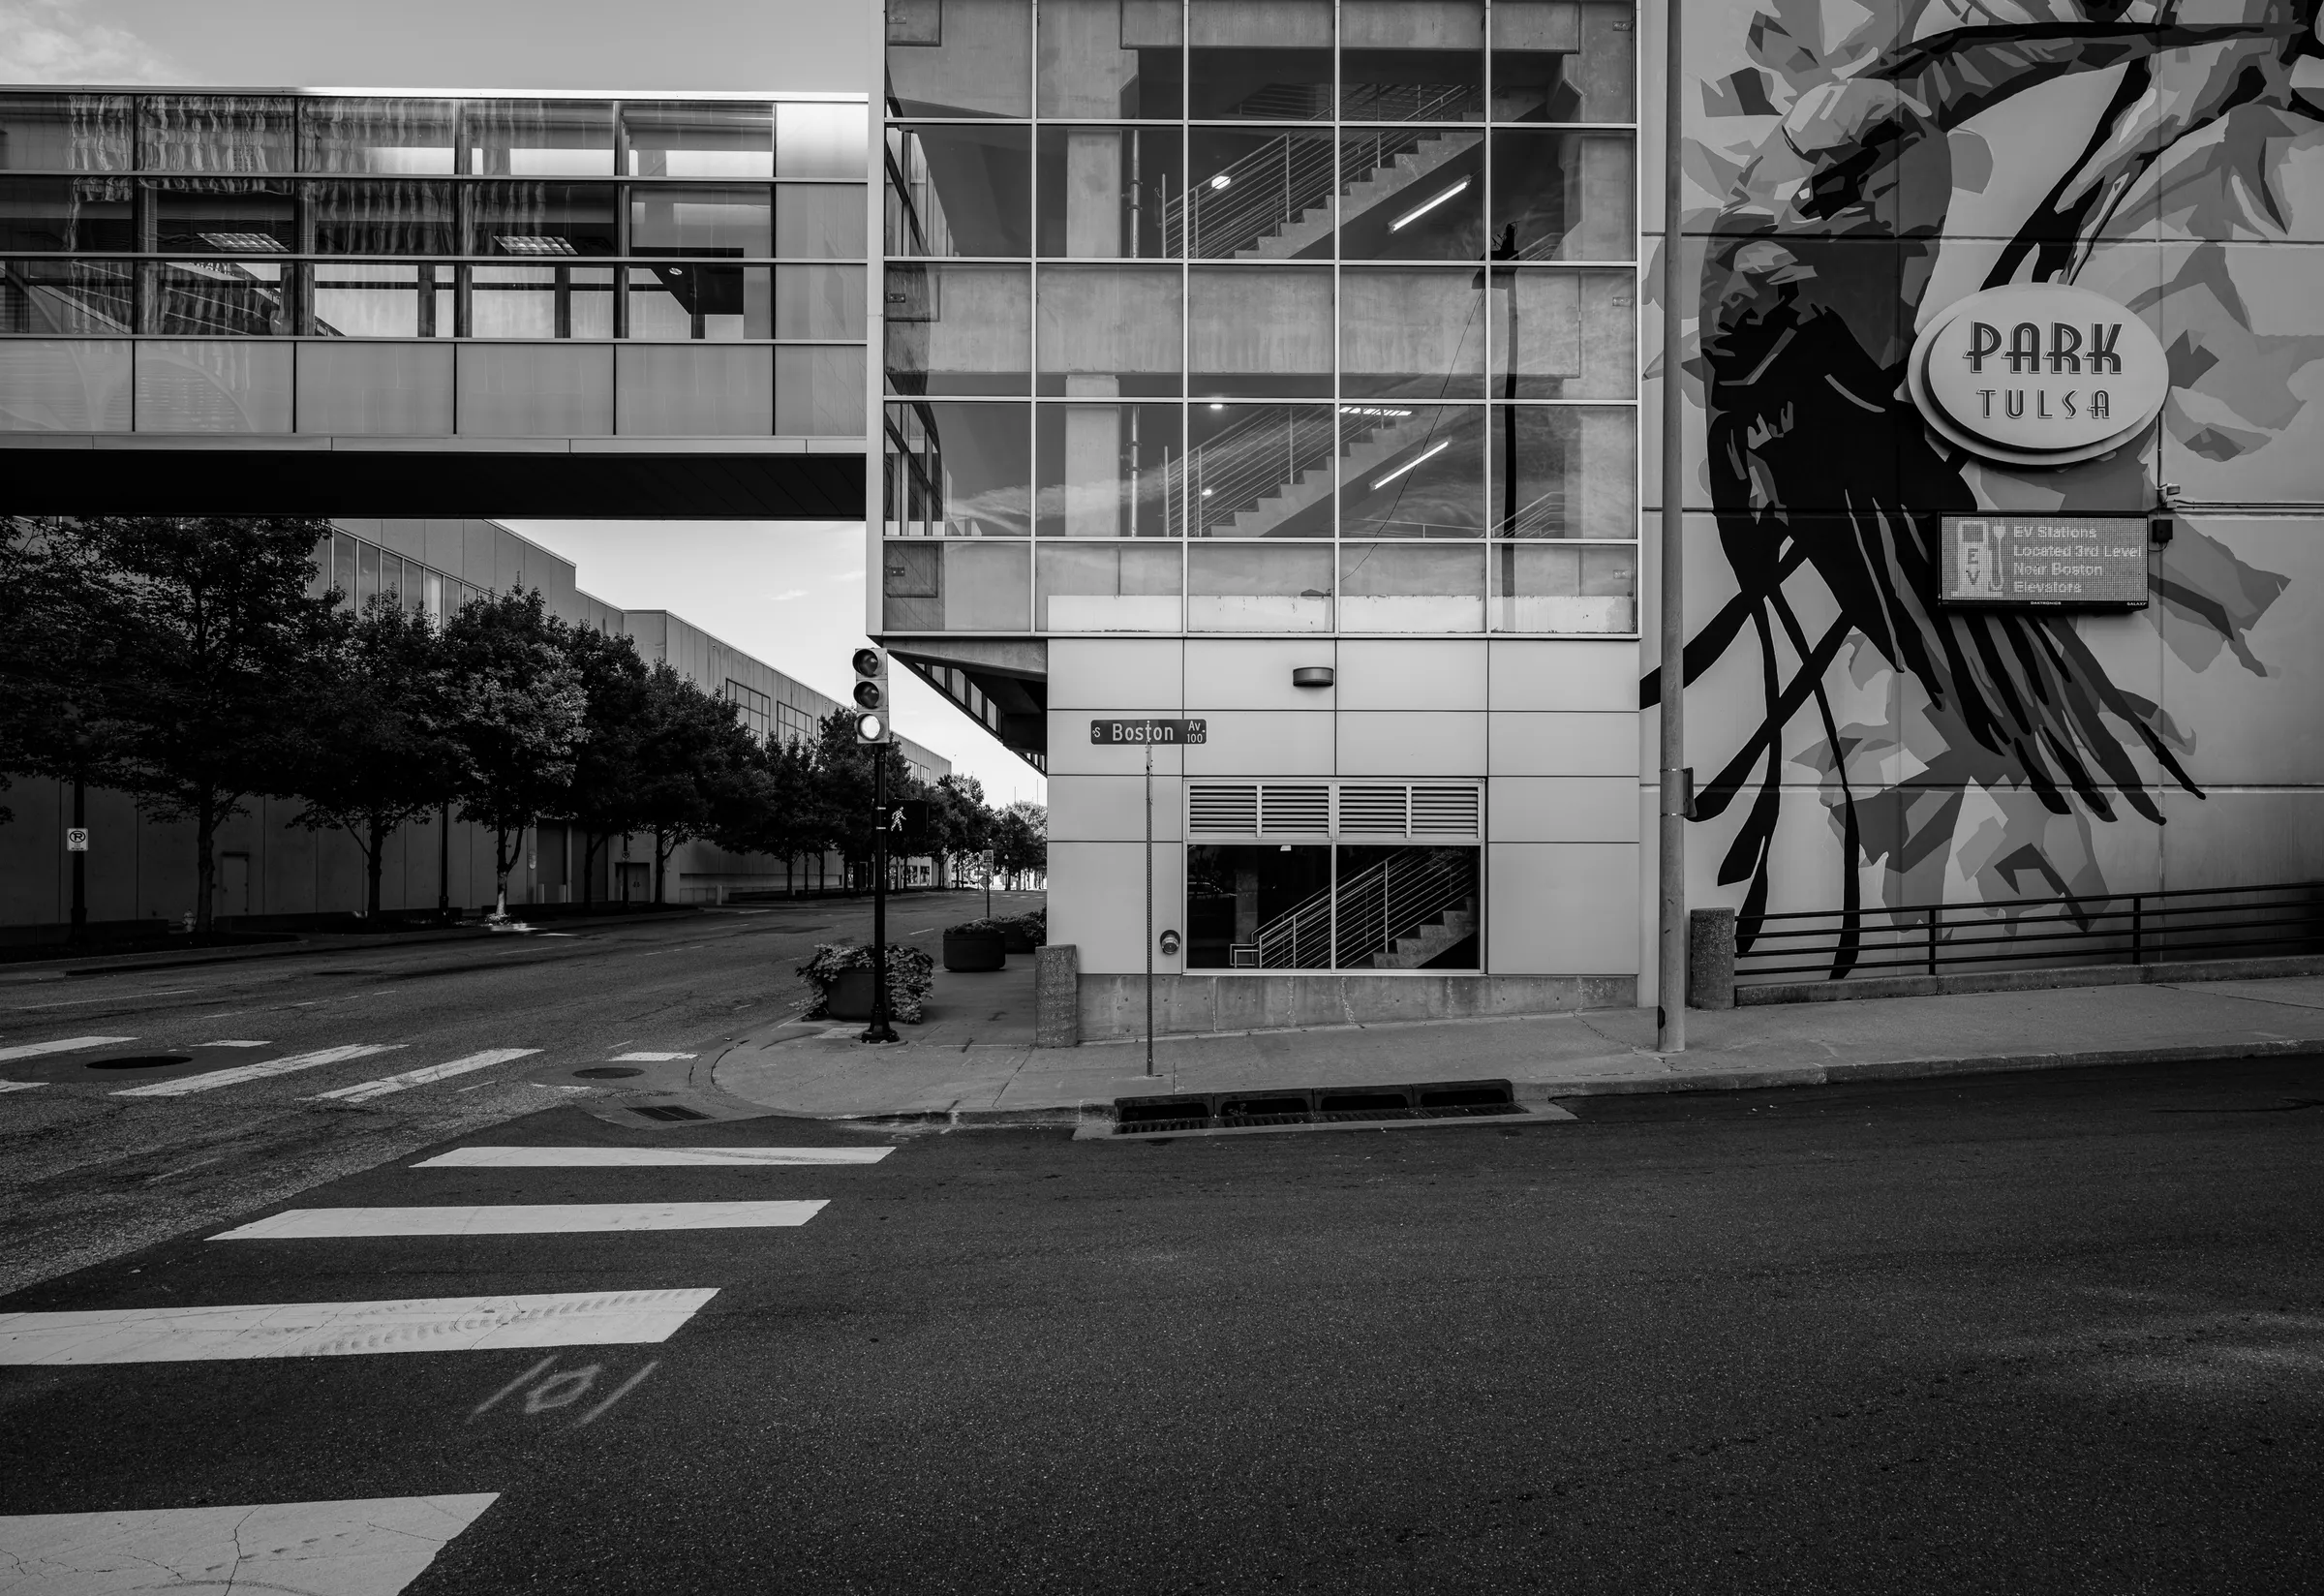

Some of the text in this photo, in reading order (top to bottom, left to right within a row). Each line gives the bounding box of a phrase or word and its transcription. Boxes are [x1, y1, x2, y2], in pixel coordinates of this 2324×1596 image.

[1963, 321, 2124, 375] PARK
[1976, 388, 2111, 419] TULSA
[2013, 526, 2097, 538] EV Stations
[2013, 545, 2142, 558] Located 3rd Level
[2051, 563, 2103, 576] Boston
[2013, 581, 2082, 594] Elevators
[1094, 721, 1201, 742] S Boston Av
[1187, 733, 1204, 744] 100
